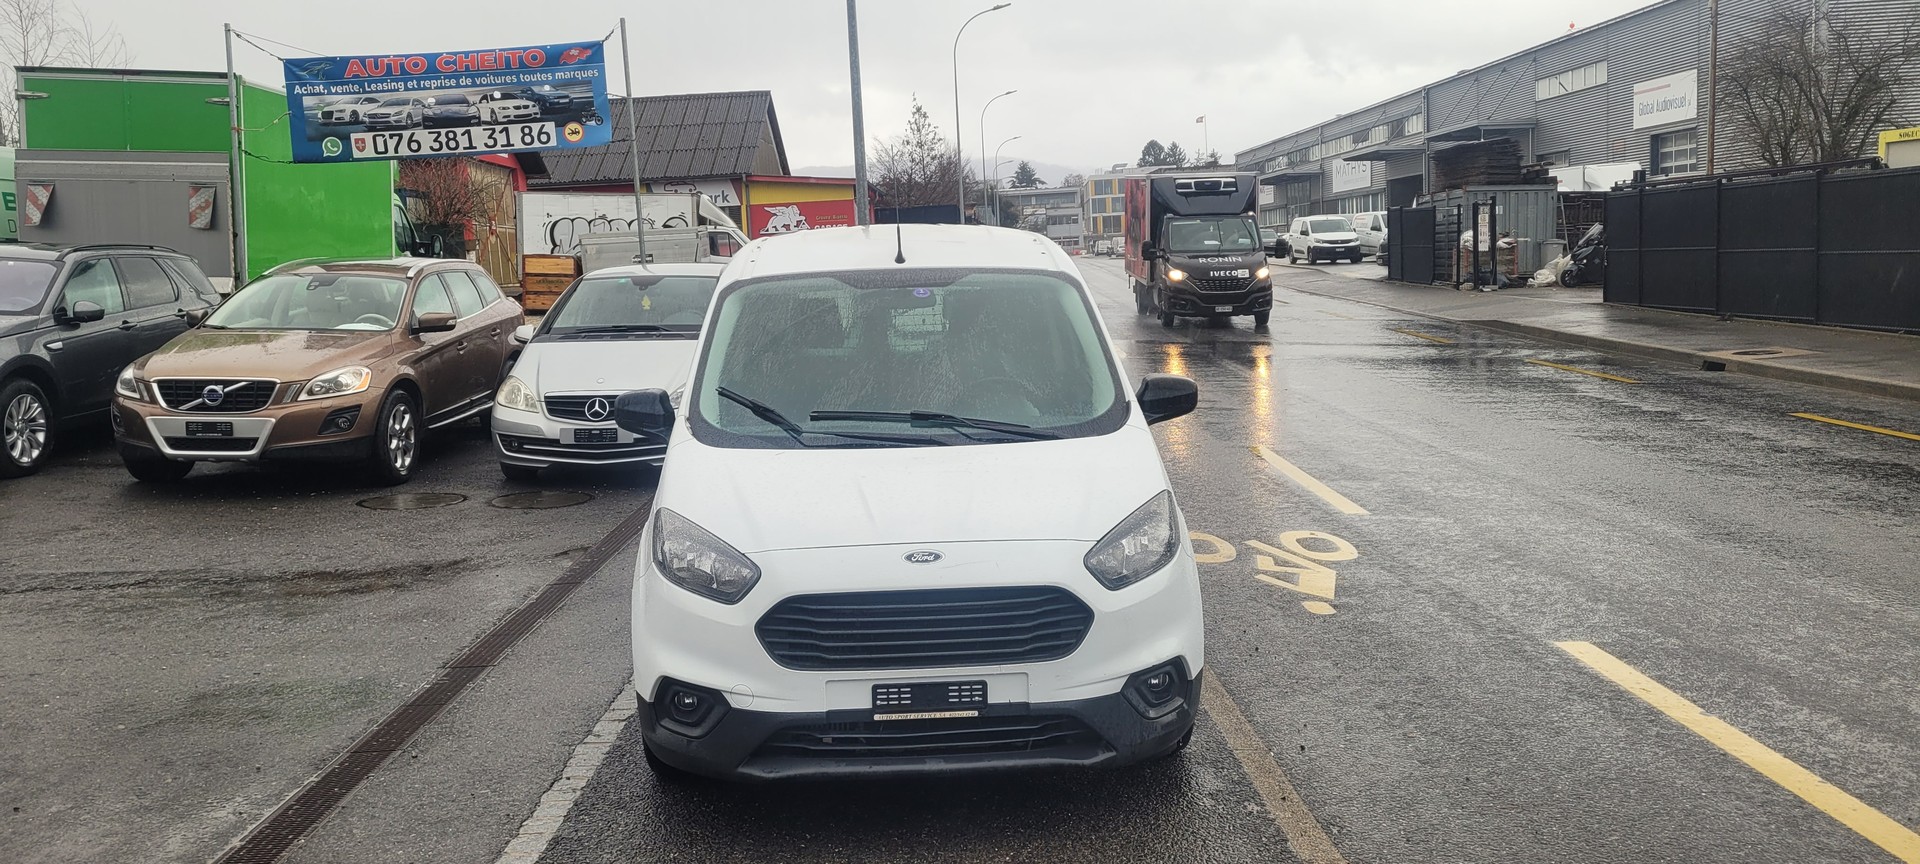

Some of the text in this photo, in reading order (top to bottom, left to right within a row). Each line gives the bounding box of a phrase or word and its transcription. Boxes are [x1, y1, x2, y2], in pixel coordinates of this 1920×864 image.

[344, 48, 546, 78] AUTO CHEITO
[294, 68, 599, 95] Achat, vente, Leasing et reprise de voitures toutes marques
[1639, 98, 1655, 117] Global
[1655, 92, 1687, 113] Audiovisuel
[372, 123, 551, 155] 076 381 31 86
[1335, 161, 1367, 179] MATHYS
[911, 552, 935, 562] Ford
